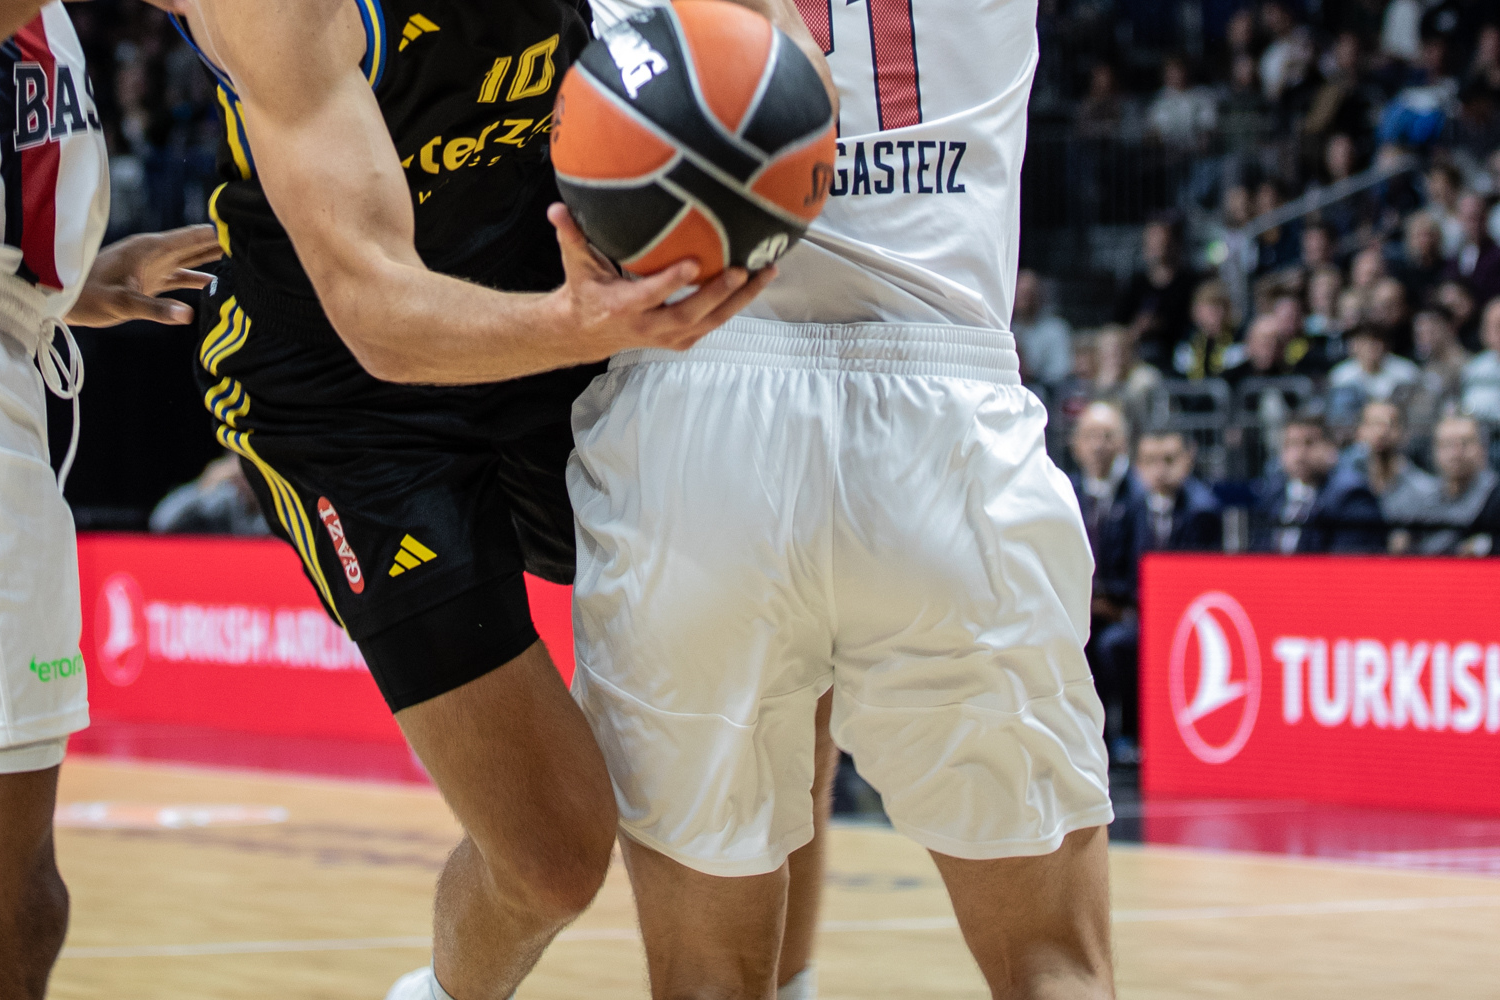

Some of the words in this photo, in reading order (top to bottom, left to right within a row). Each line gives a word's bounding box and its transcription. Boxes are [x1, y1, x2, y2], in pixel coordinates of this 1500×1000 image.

[477, 34, 560, 103] 10
[830, 141, 967, 197] GASTEIZ
[318, 504, 362, 585] GAZI
